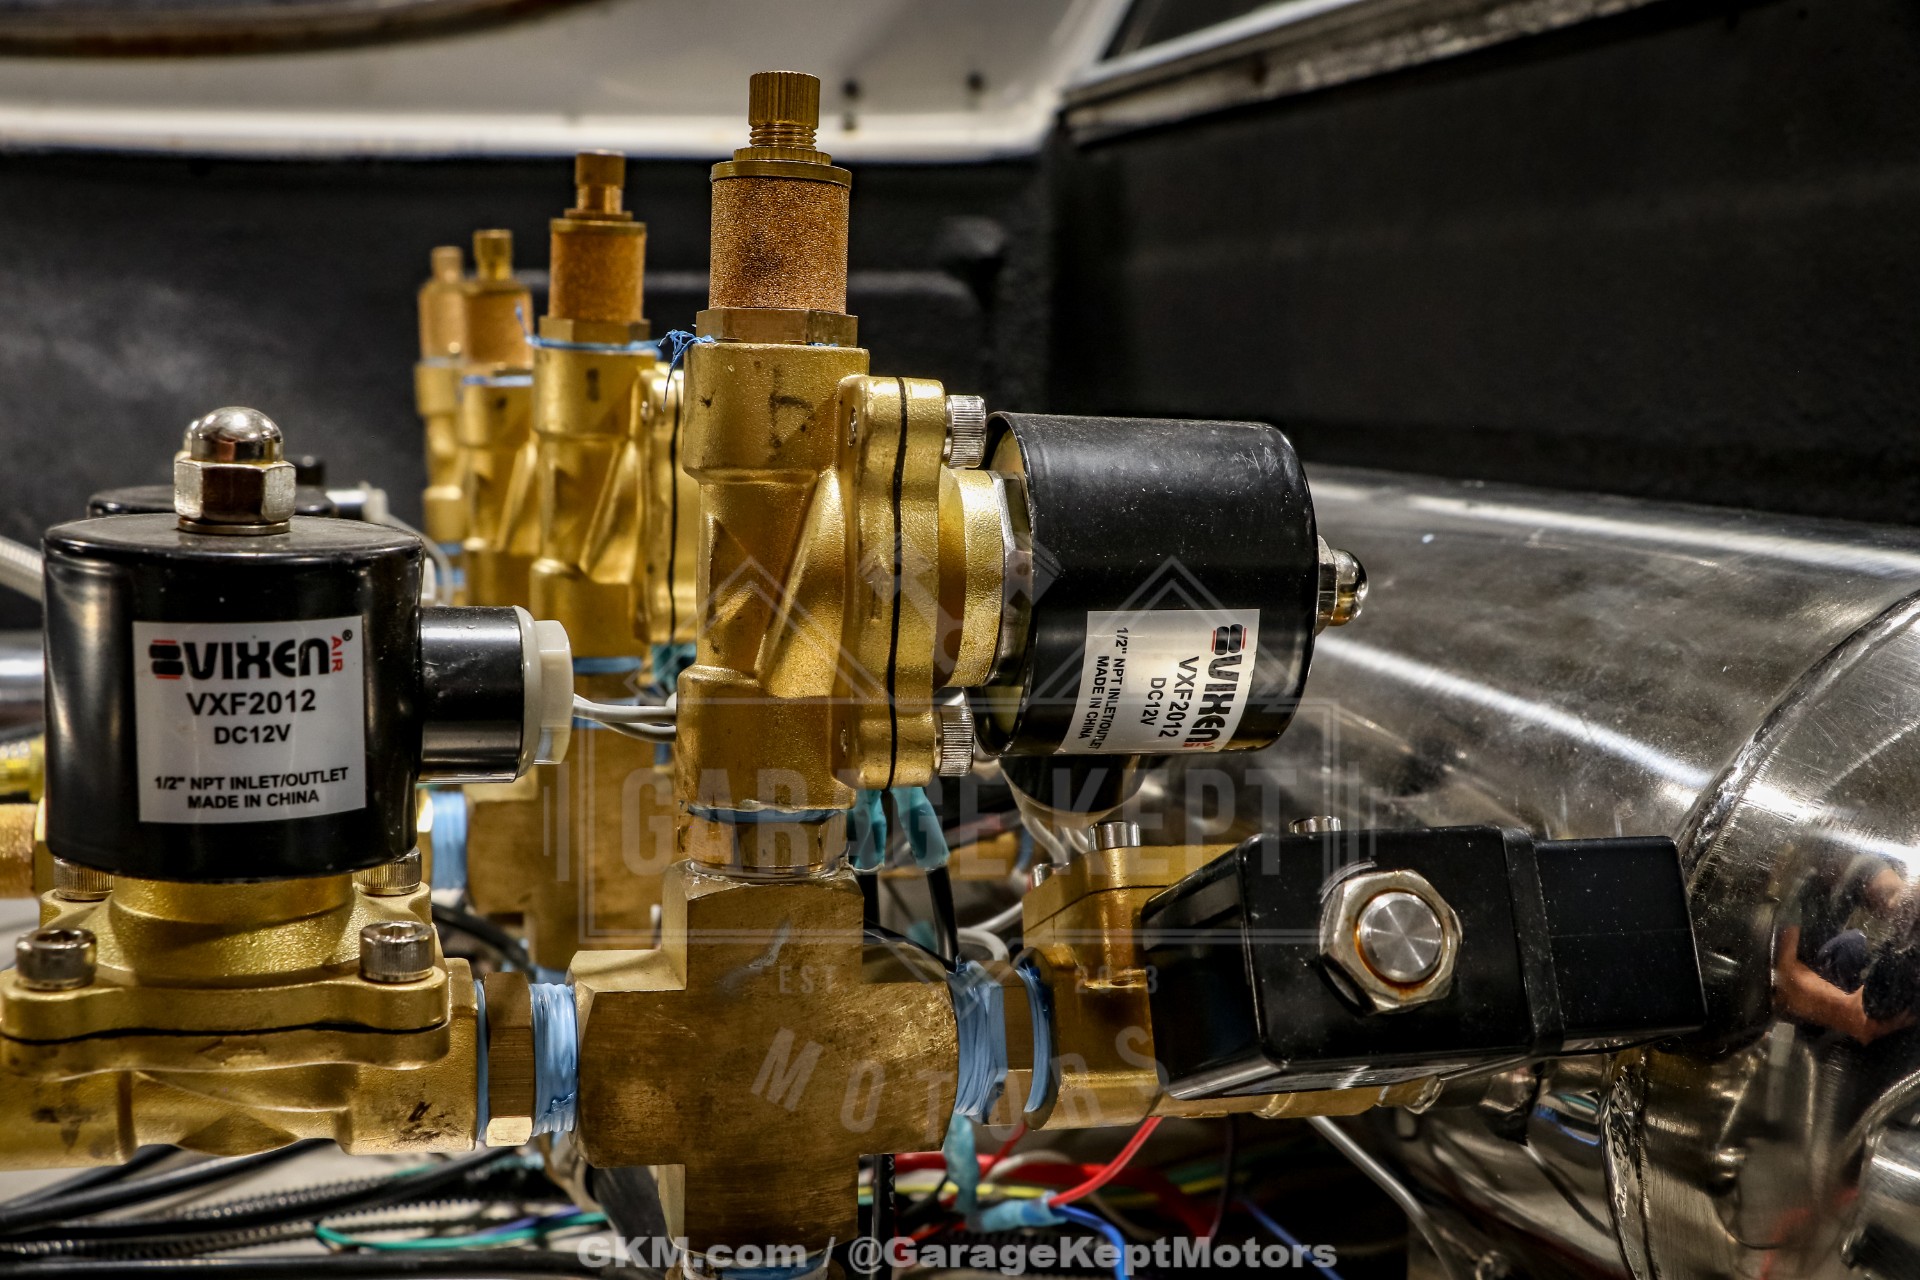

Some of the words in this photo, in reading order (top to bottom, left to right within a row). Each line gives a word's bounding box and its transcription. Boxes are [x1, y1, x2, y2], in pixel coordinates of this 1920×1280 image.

[331, 635, 343, 673] AIR
[1115, 627, 1129, 654] 1/2"
[183, 638, 330, 680] VIXEN
[1111, 658, 1126, 685] NPT
[1092, 656, 1110, 694] MADE
[186, 689, 316, 716] VXF2012
[1088, 697, 1102, 711] IN
[1141, 677, 1167, 726] DC12V
[1158, 655, 1200, 738] VXF2012
[1184, 654, 1243, 743] VIXEN
[1078, 711, 1099, 740] CHINA
[1087, 687, 1121, 750] INLET/OUTLET
[214, 724, 291, 745] DC12V
[154, 776, 185, 790] 1/2"
[190, 777, 225, 790] NPT
[230, 767, 349, 790] INLET/OUTLET
[187, 795, 239, 809] MADE
[244, 794, 262, 808] IN
[267, 789, 319, 807] CHINA
